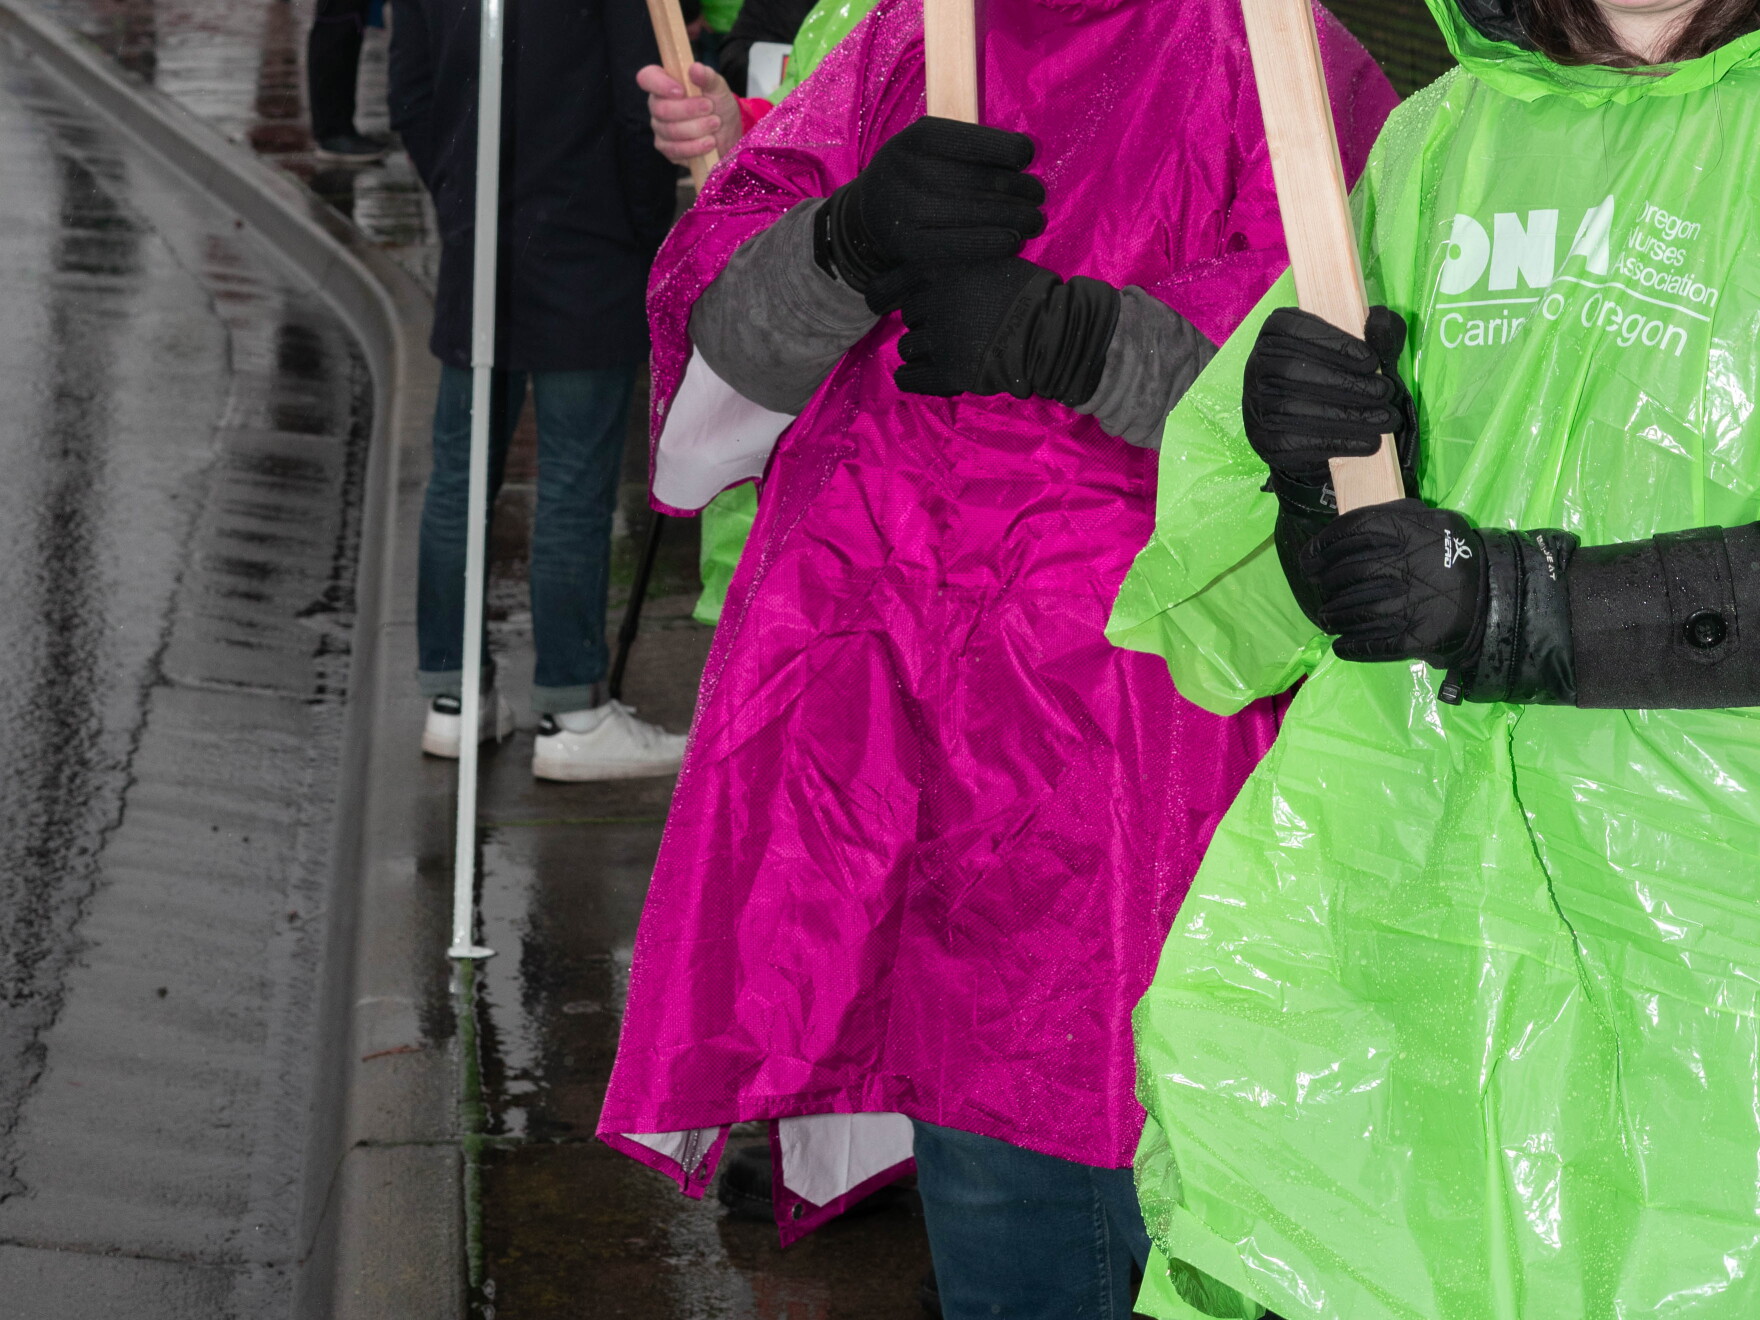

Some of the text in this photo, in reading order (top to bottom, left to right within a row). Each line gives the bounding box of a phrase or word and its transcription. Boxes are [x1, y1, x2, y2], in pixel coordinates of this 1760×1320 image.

[1439, 194, 1614, 295] ONA
[1611, 252, 1718, 308] Association
[1580, 293, 1688, 357] Oregon
